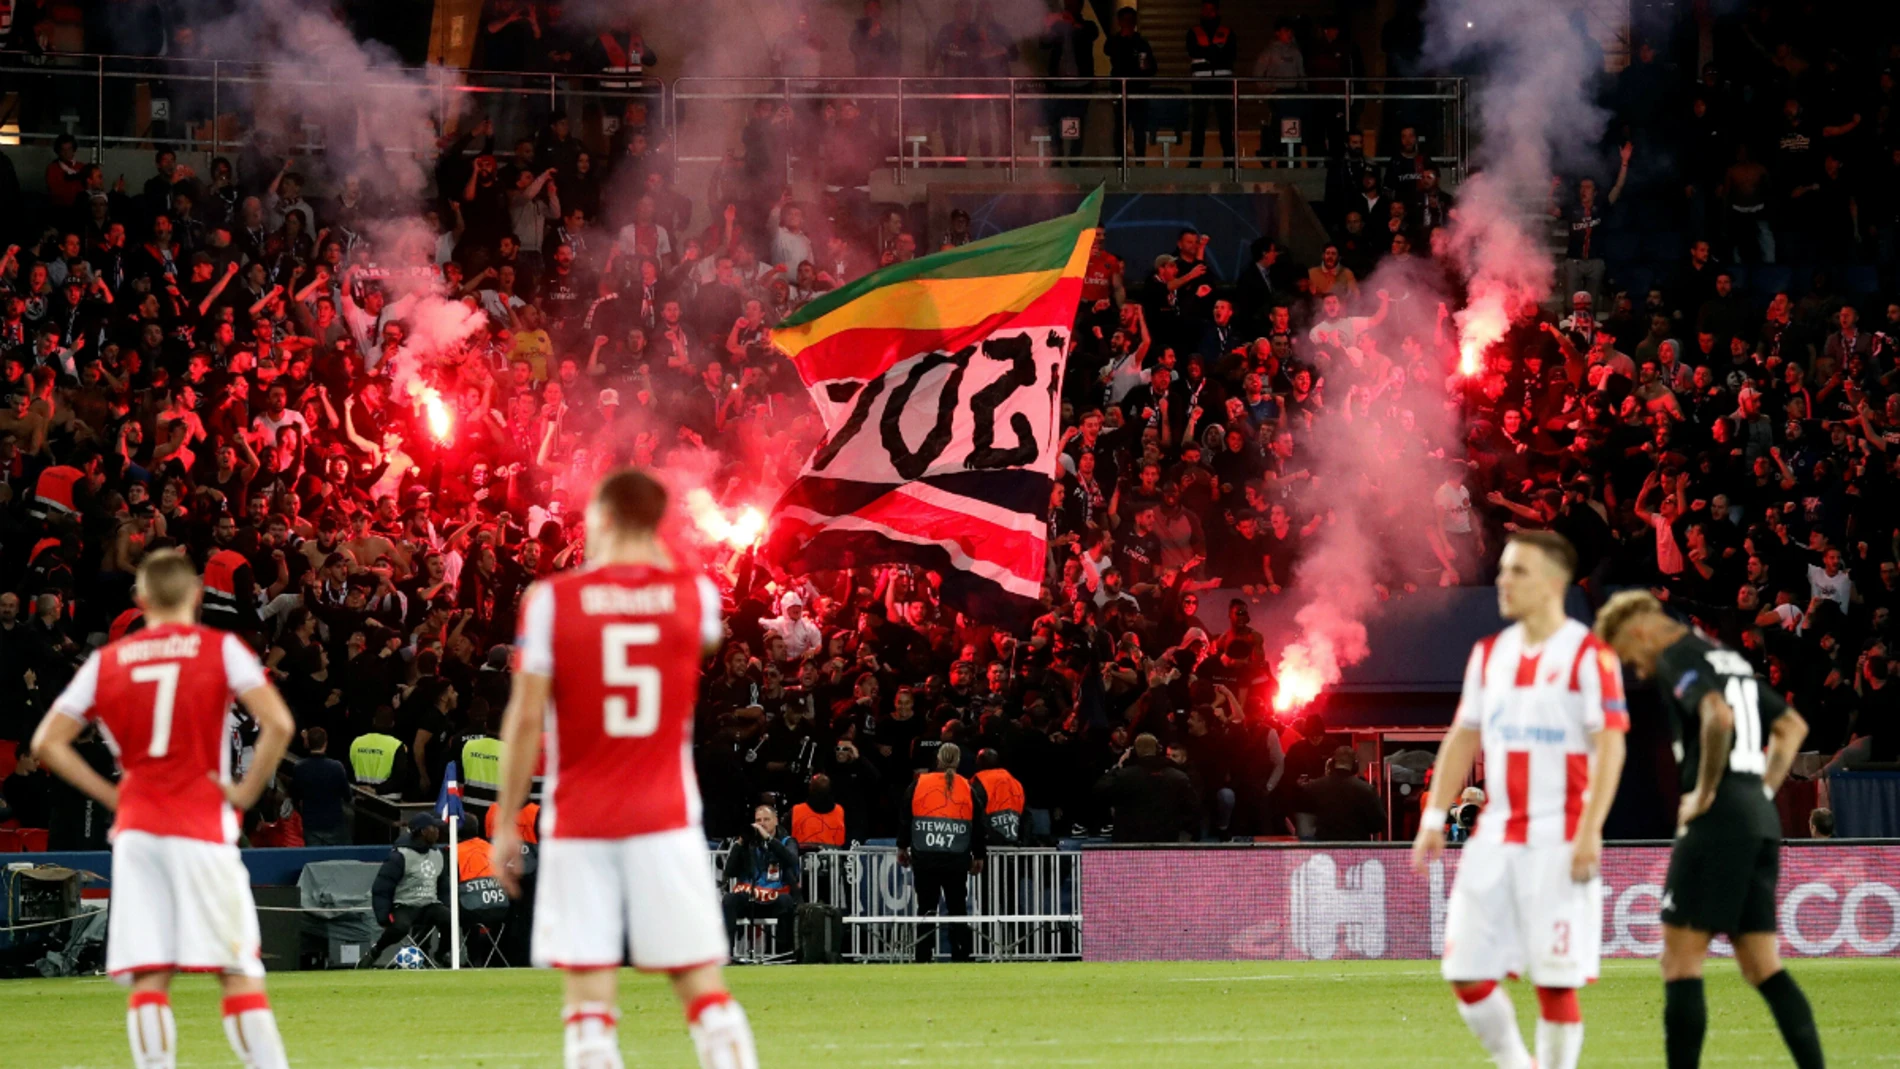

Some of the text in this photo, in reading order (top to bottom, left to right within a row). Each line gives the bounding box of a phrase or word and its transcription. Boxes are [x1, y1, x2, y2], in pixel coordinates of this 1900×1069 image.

[602, 623, 662, 737] 5
[130, 662, 181, 758] 7
[915, 820, 967, 834] STEWARD
[925, 832, 955, 848] 047
[482, 889, 506, 904] 095
[1553, 919, 1571, 957] 3
